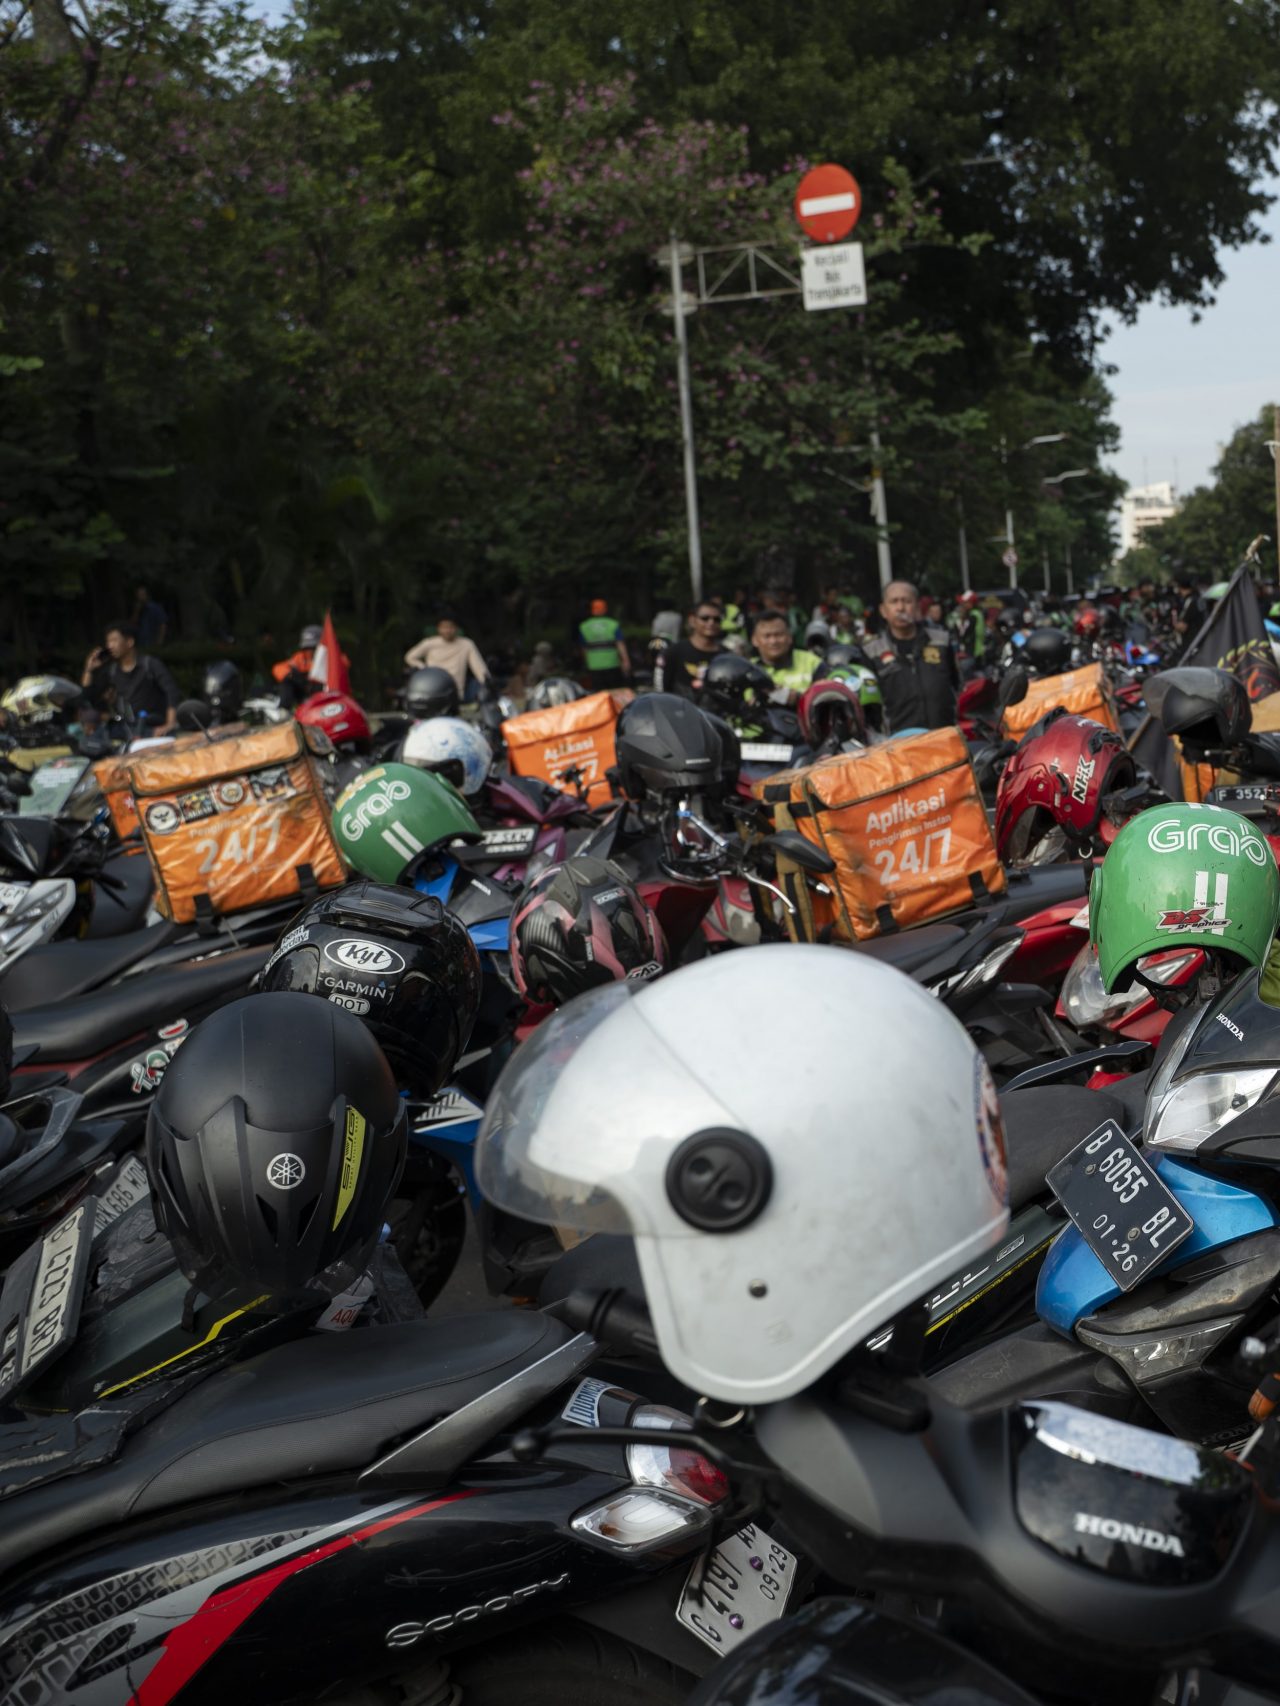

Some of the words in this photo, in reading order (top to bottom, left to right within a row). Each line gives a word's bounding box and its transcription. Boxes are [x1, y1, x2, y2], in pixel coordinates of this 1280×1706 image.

[1072, 755, 1096, 805] NHK
[341, 780, 412, 842] Grab
[865, 787, 946, 834] Aplikasi
[195, 816, 281, 875] 24/7
[874, 827, 952, 887] 24/7
[1147, 819, 1267, 867] Grab
[344, 943, 386, 968] Kyt
[324, 976, 388, 999] GARMIN
[334, 996, 366, 1013] DOT
[1215, 1012, 1245, 1042] HONDA
[1085, 1129, 1113, 1155] B
[1098, 1147, 1149, 1204] 6055
[51, 1214, 78, 1243] B
[1141, 1206, 1177, 1249] BL
[26, 1304, 62, 1369] BRZ
[1073, 1511, 1185, 1557] HONDA
